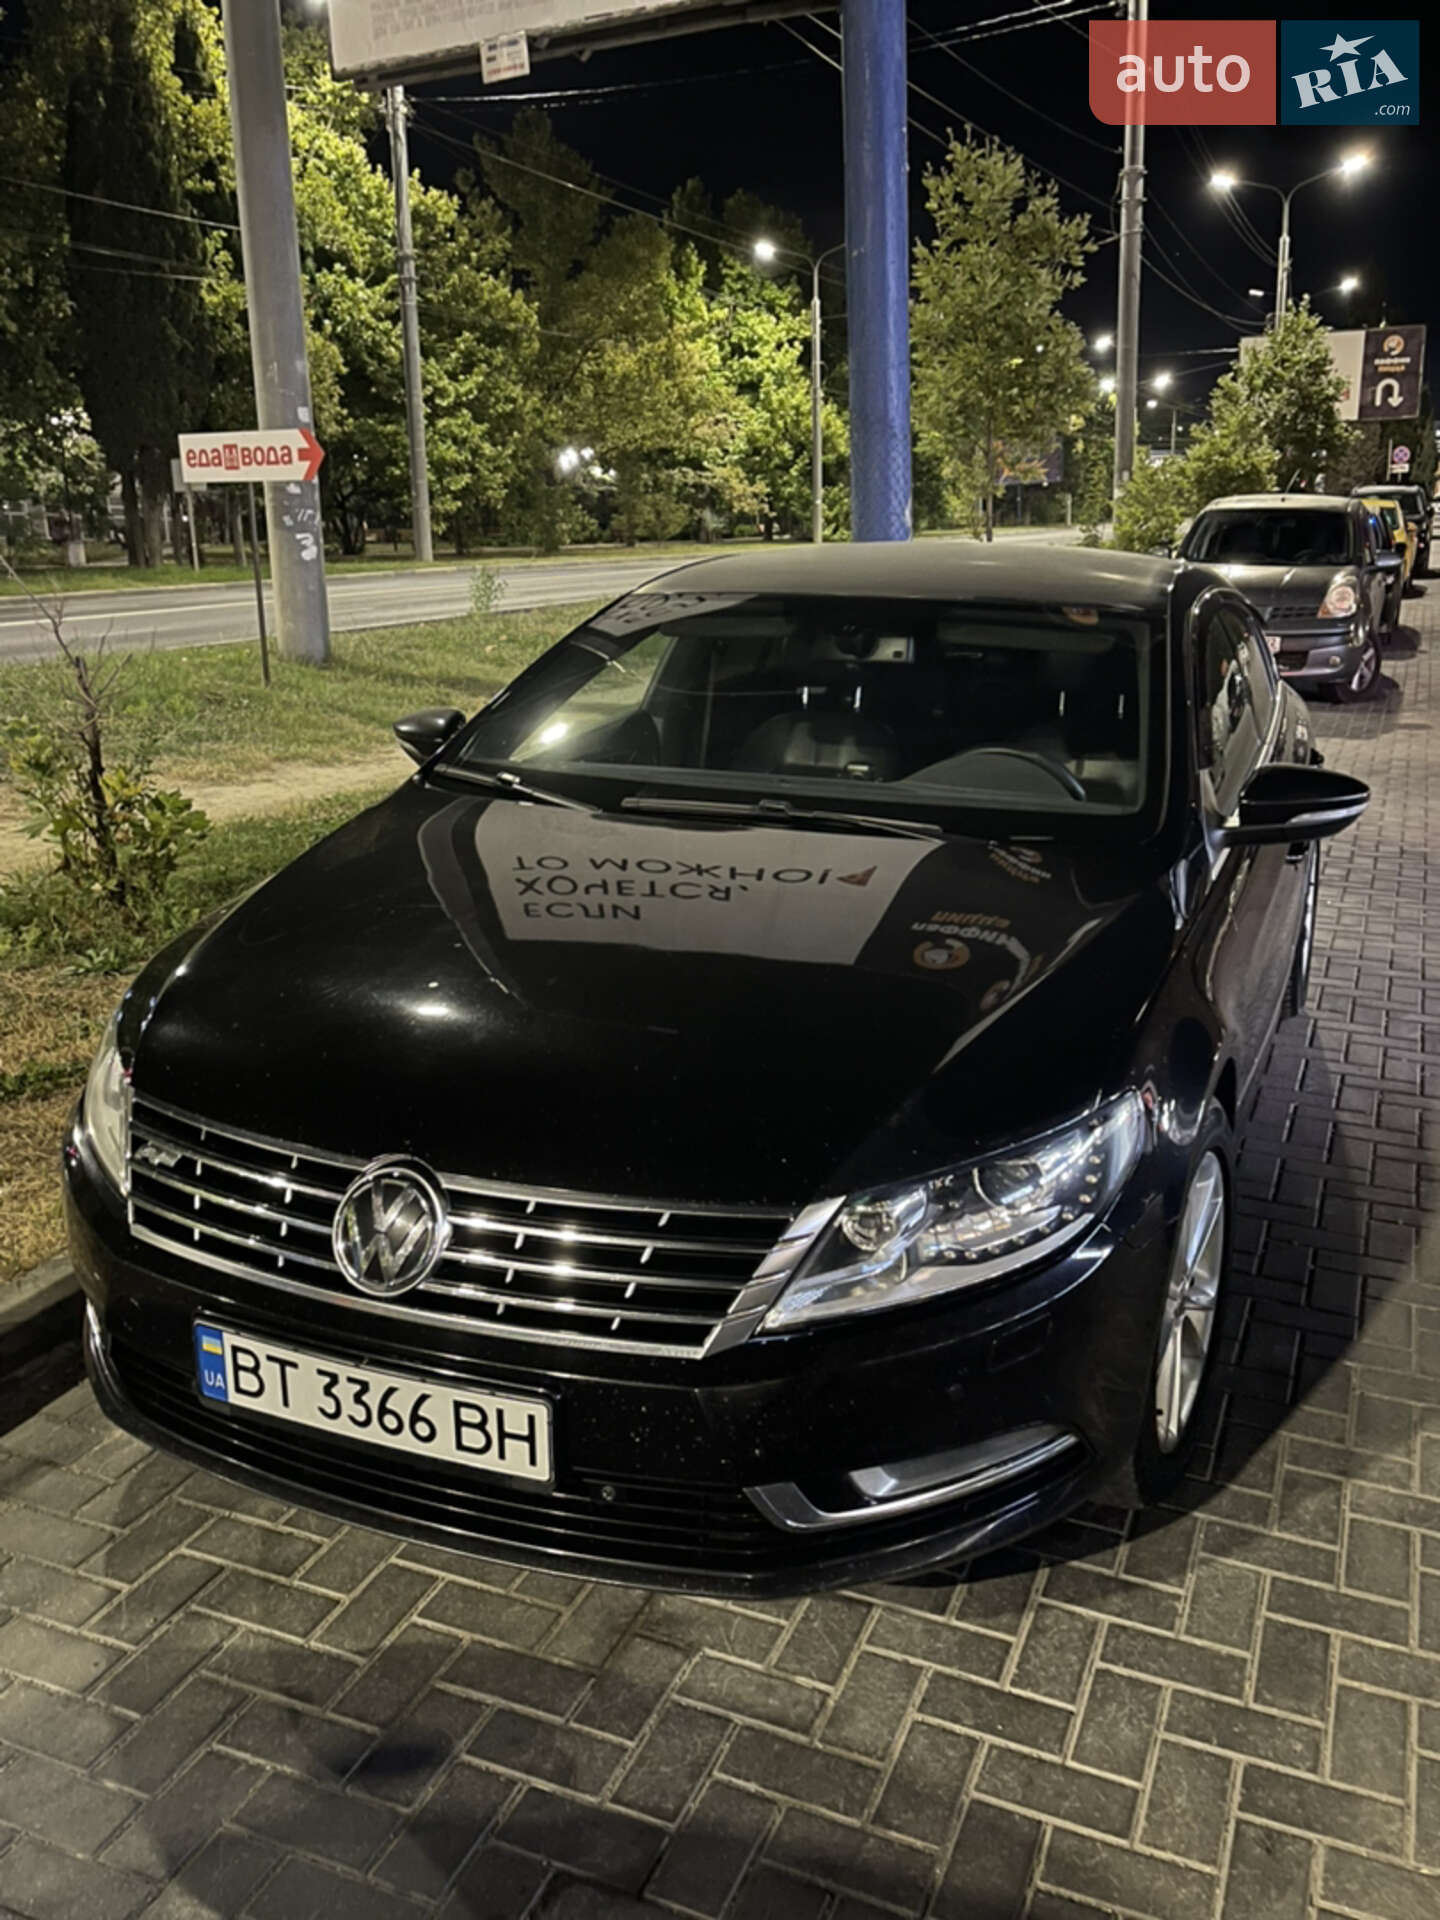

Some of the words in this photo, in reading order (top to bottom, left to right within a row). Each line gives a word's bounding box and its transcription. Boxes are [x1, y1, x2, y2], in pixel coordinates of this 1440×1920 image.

[204, 1370, 225, 1389] UA
[231, 1345, 299, 1408] BT
[316, 1369, 437, 1443] 3366
[453, 1400, 537, 1467] BH
